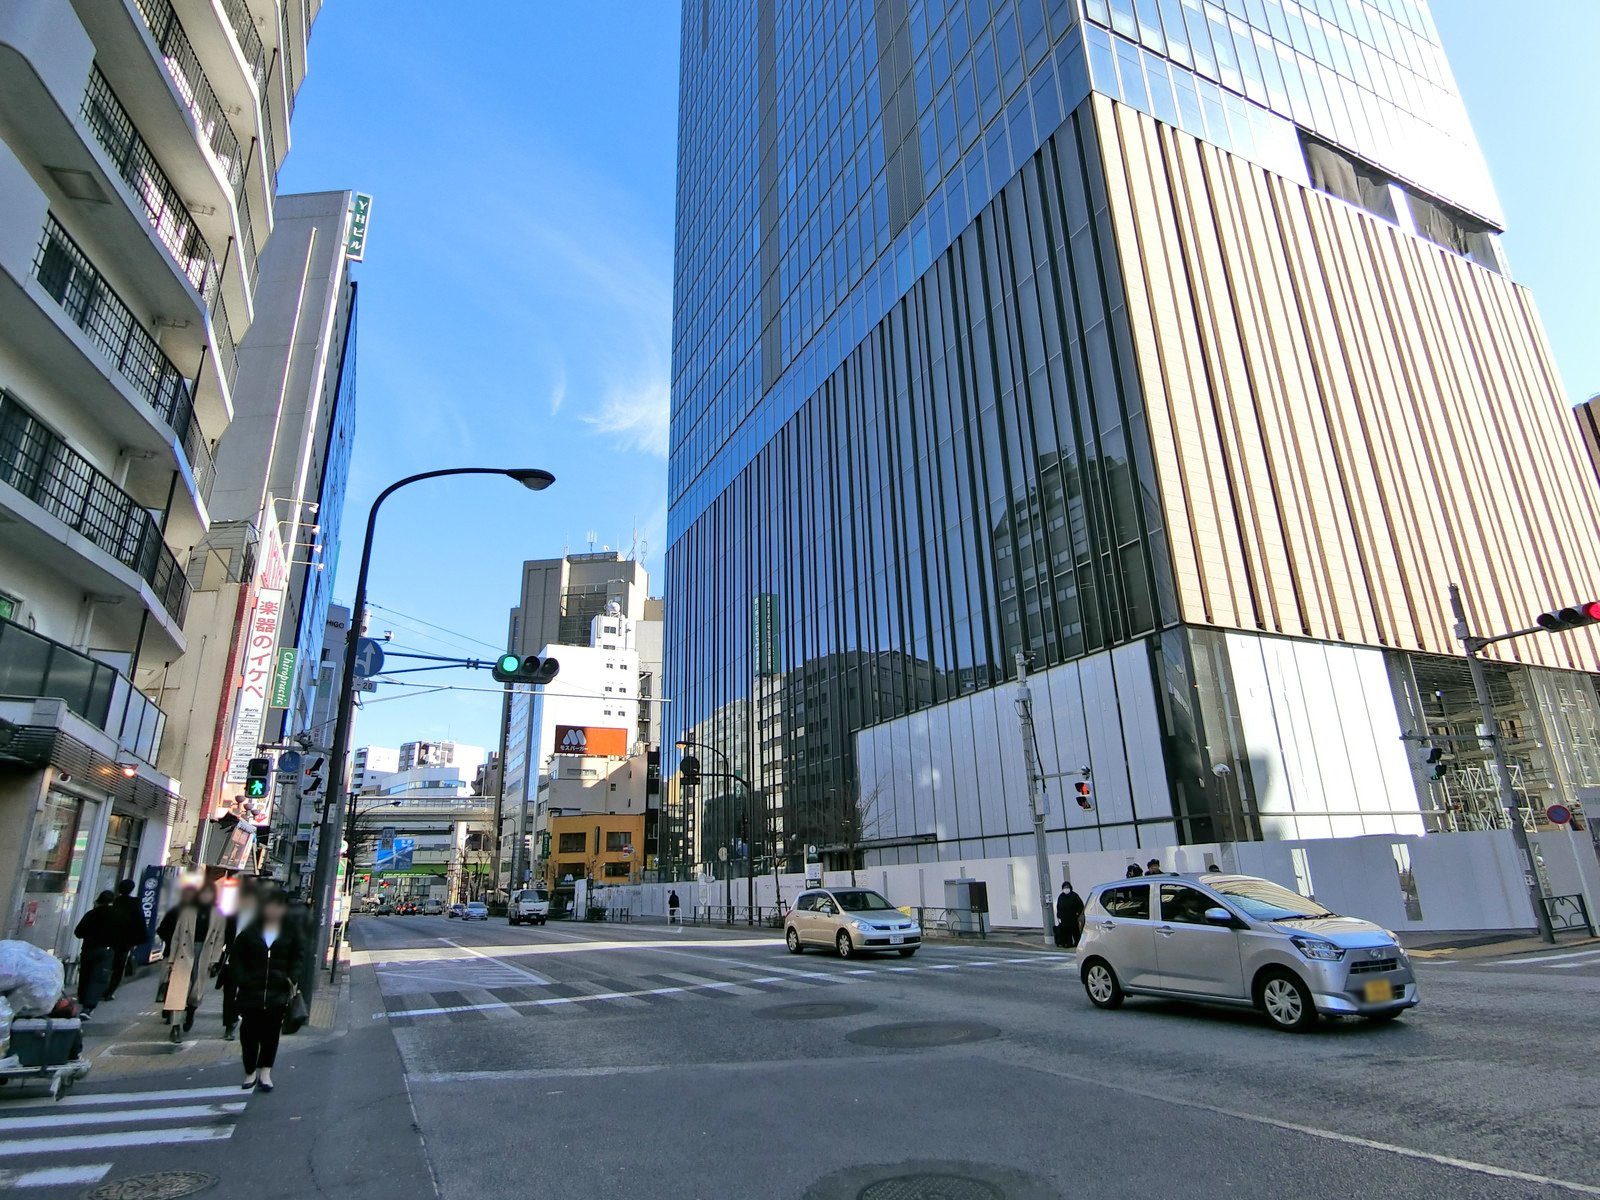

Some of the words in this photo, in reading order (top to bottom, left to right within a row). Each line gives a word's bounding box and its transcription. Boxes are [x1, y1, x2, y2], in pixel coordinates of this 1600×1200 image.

[244, 600, 279, 699] 楽器のイケベ
[276, 652, 295, 705] Chiropractic
[142, 890, 156, 917] BOSS
